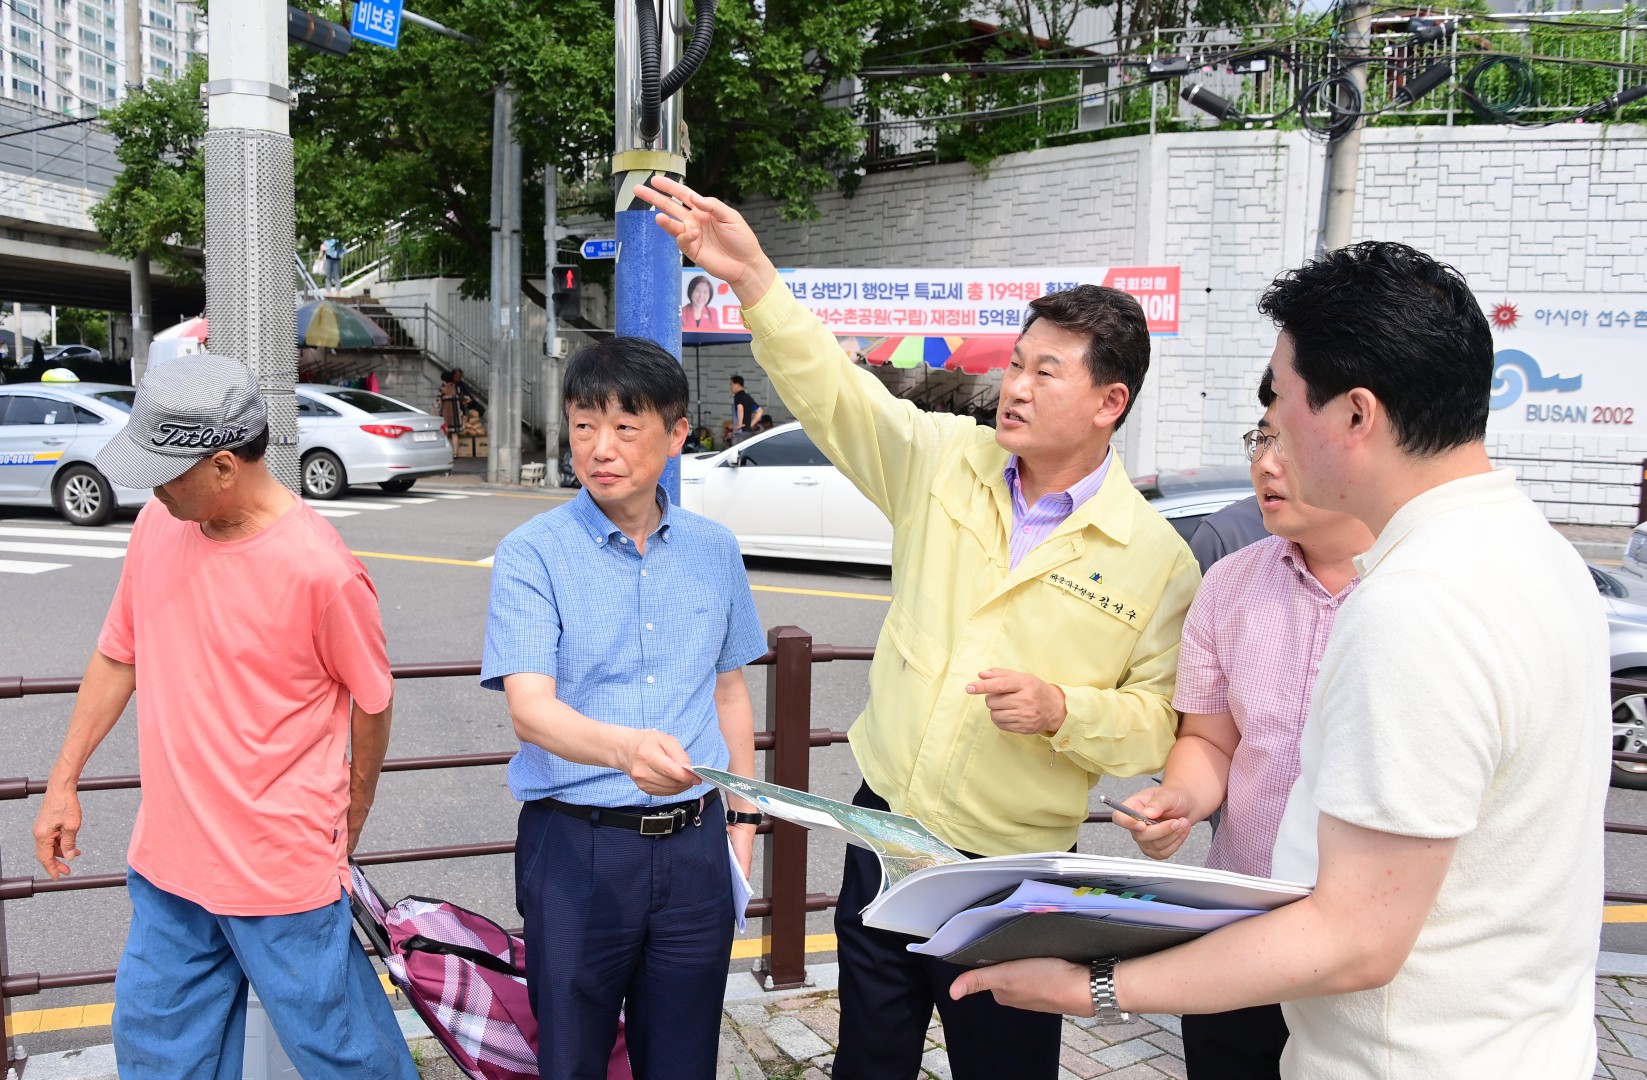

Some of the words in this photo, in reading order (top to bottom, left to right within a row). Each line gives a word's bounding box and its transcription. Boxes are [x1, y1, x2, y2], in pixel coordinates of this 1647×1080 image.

[358, 1, 395, 36] 비보호
[811, 282, 858, 300] 상반기
[862, 282, 910, 300] 행안부
[914, 282, 963, 300] 특교세
[967, 282, 984, 300] 총
[988, 282, 1041, 300] 19억원
[1113, 276, 1167, 291] 국회의원
[810, 308, 928, 326] 선수촌공원(구립)
[931, 309, 976, 326] 재정비
[979, 309, 1020, 326] 5억원
[1535, 309, 1589, 327] 아시아
[1596, 310, 1647, 328] 선수촌
[1526, 404, 1588, 423] BUSAN
[1592, 406, 1634, 425] 2002
[151, 423, 248, 448] Titleist
